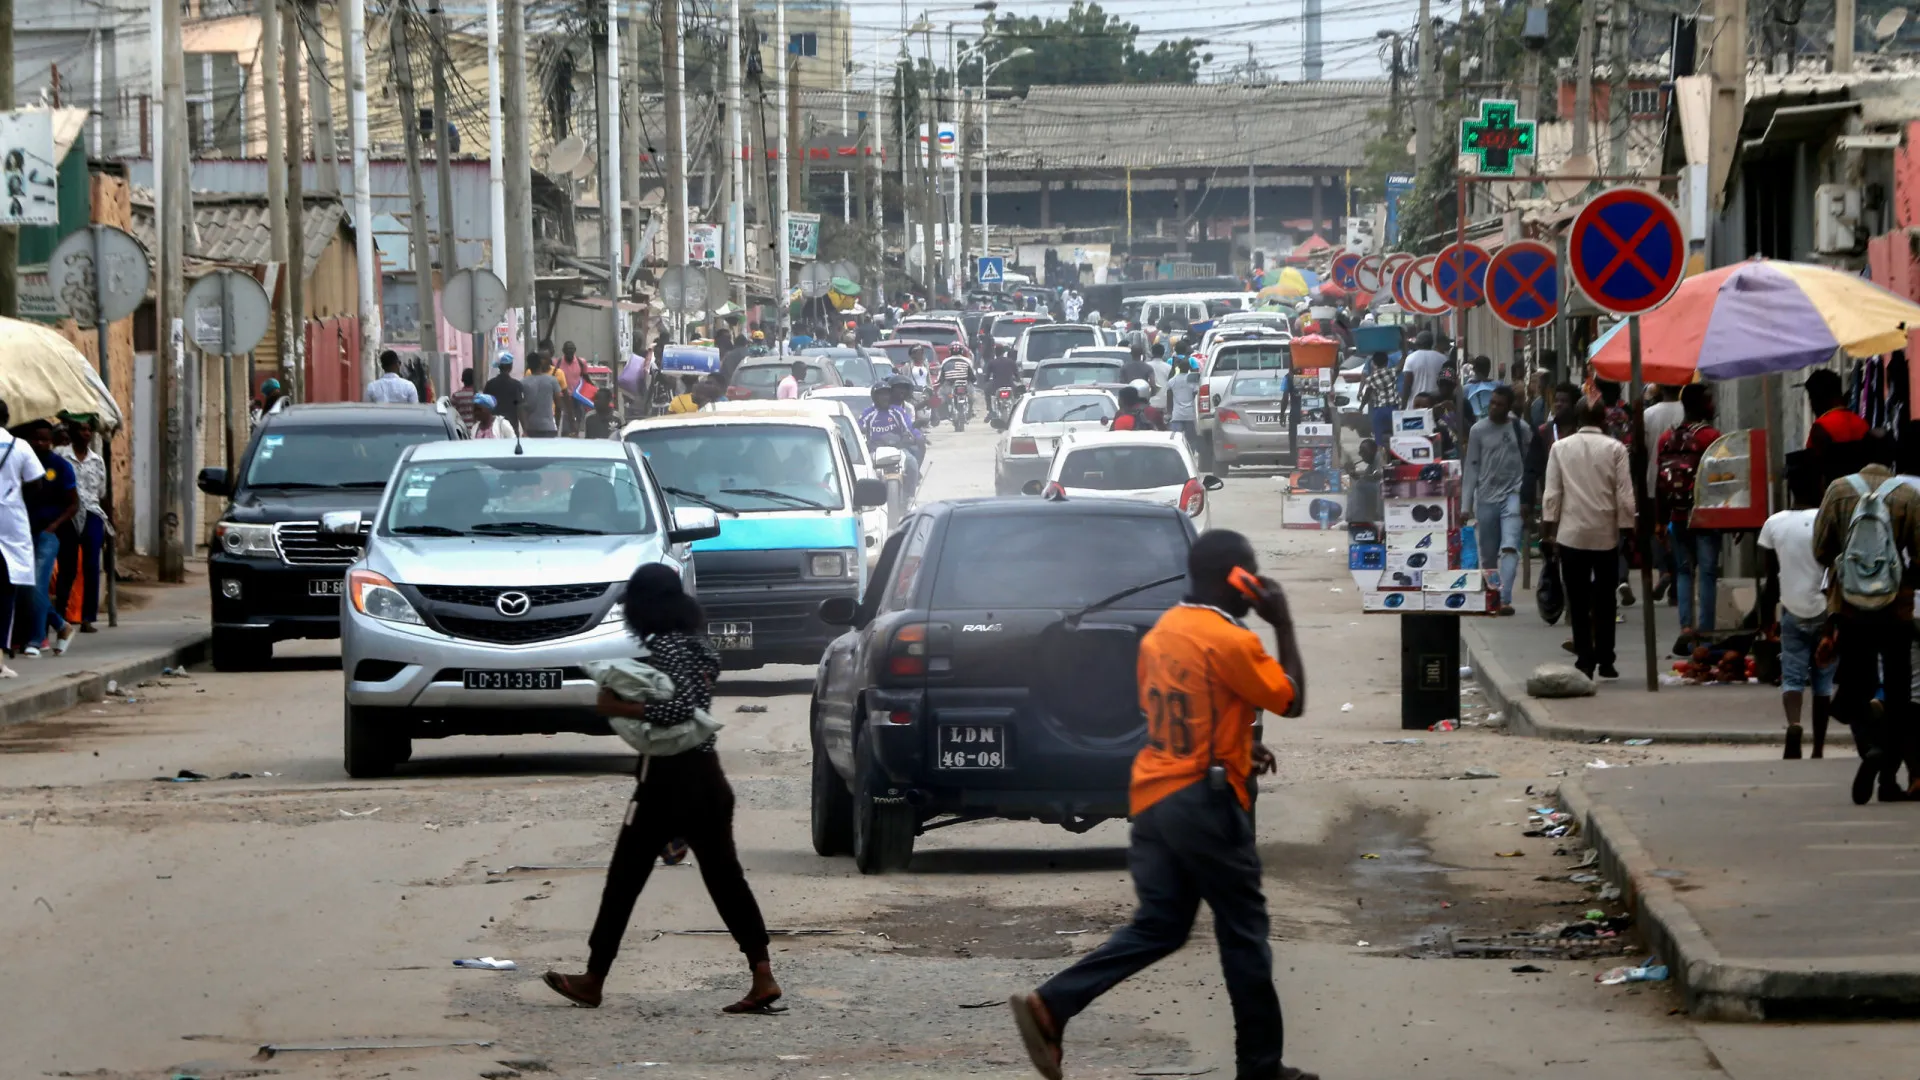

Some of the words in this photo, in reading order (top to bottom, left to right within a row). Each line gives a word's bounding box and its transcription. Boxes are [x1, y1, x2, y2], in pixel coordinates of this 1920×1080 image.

[872, 424, 896, 433] TOYOT
[942, 751, 1001, 767] 46-08
[873, 796, 905, 804] TOYOT
